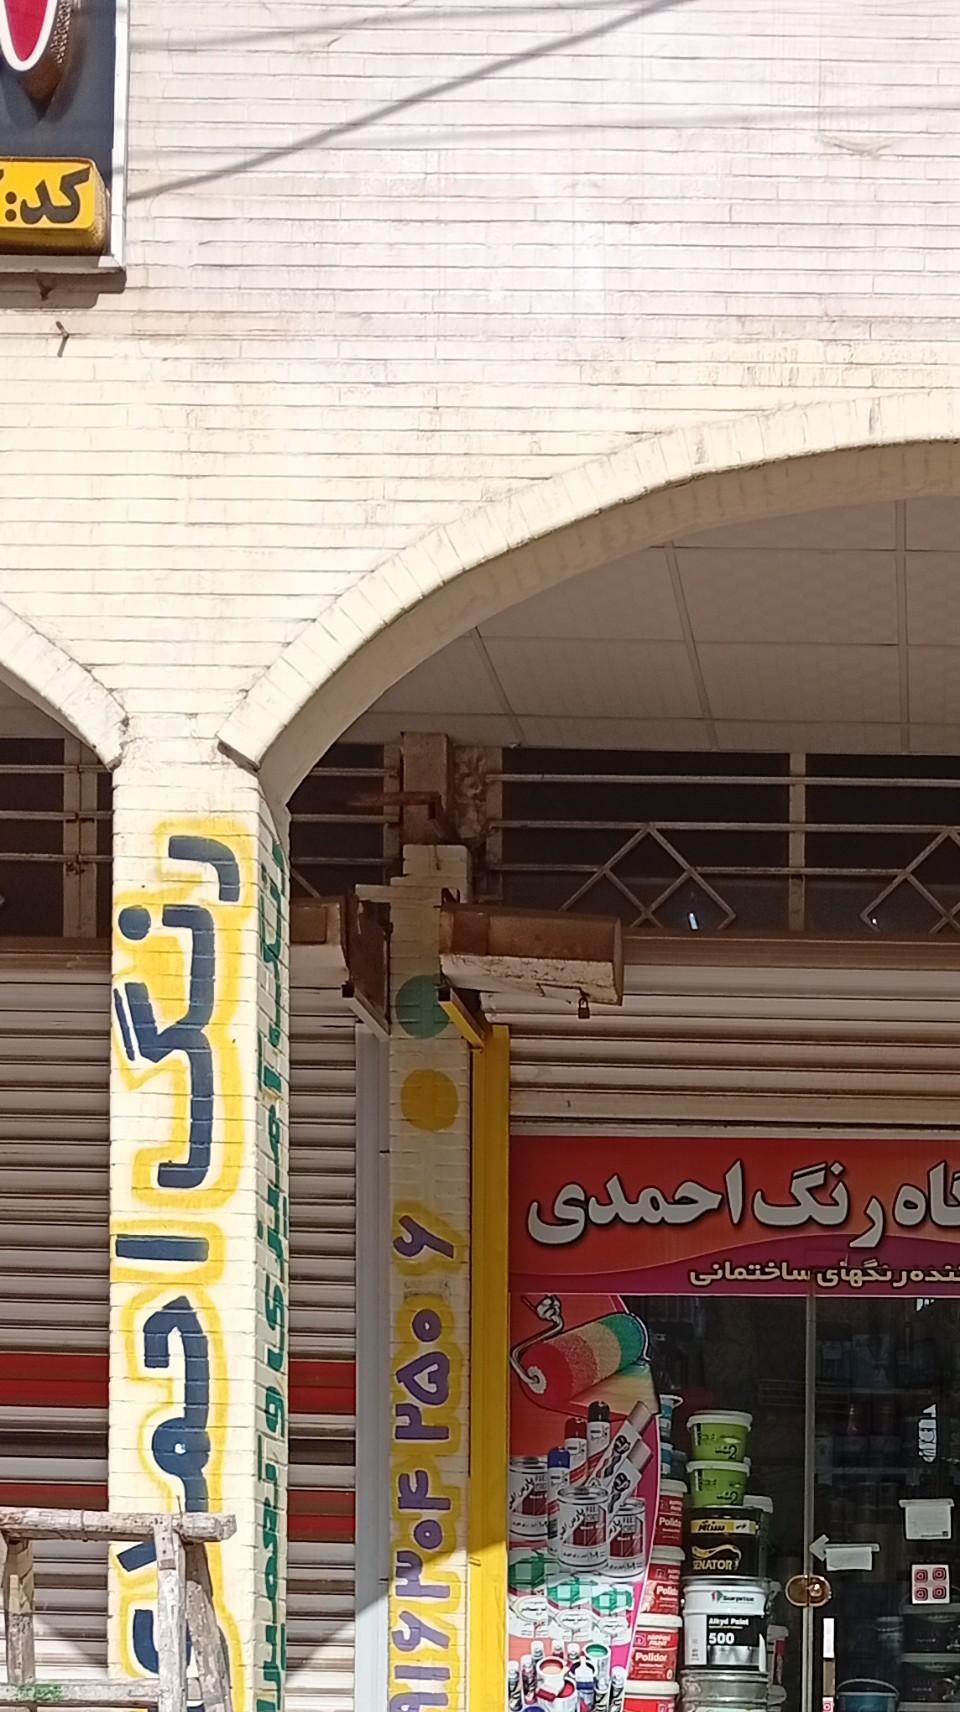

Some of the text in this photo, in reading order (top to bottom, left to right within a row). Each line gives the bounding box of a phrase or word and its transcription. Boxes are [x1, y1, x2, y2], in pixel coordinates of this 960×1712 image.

[113, 834, 240, 1188] رنگ
[527, 1159, 744, 1245] احمدی
[753, 1161, 885, 1249] رنگ
[689, 1261, 812, 1287] ساختمانی
[816, 1258, 911, 1289] رنگهای
[708, 1632, 735, 1645] 500
[635, 1652, 668, 1662] Polidor
